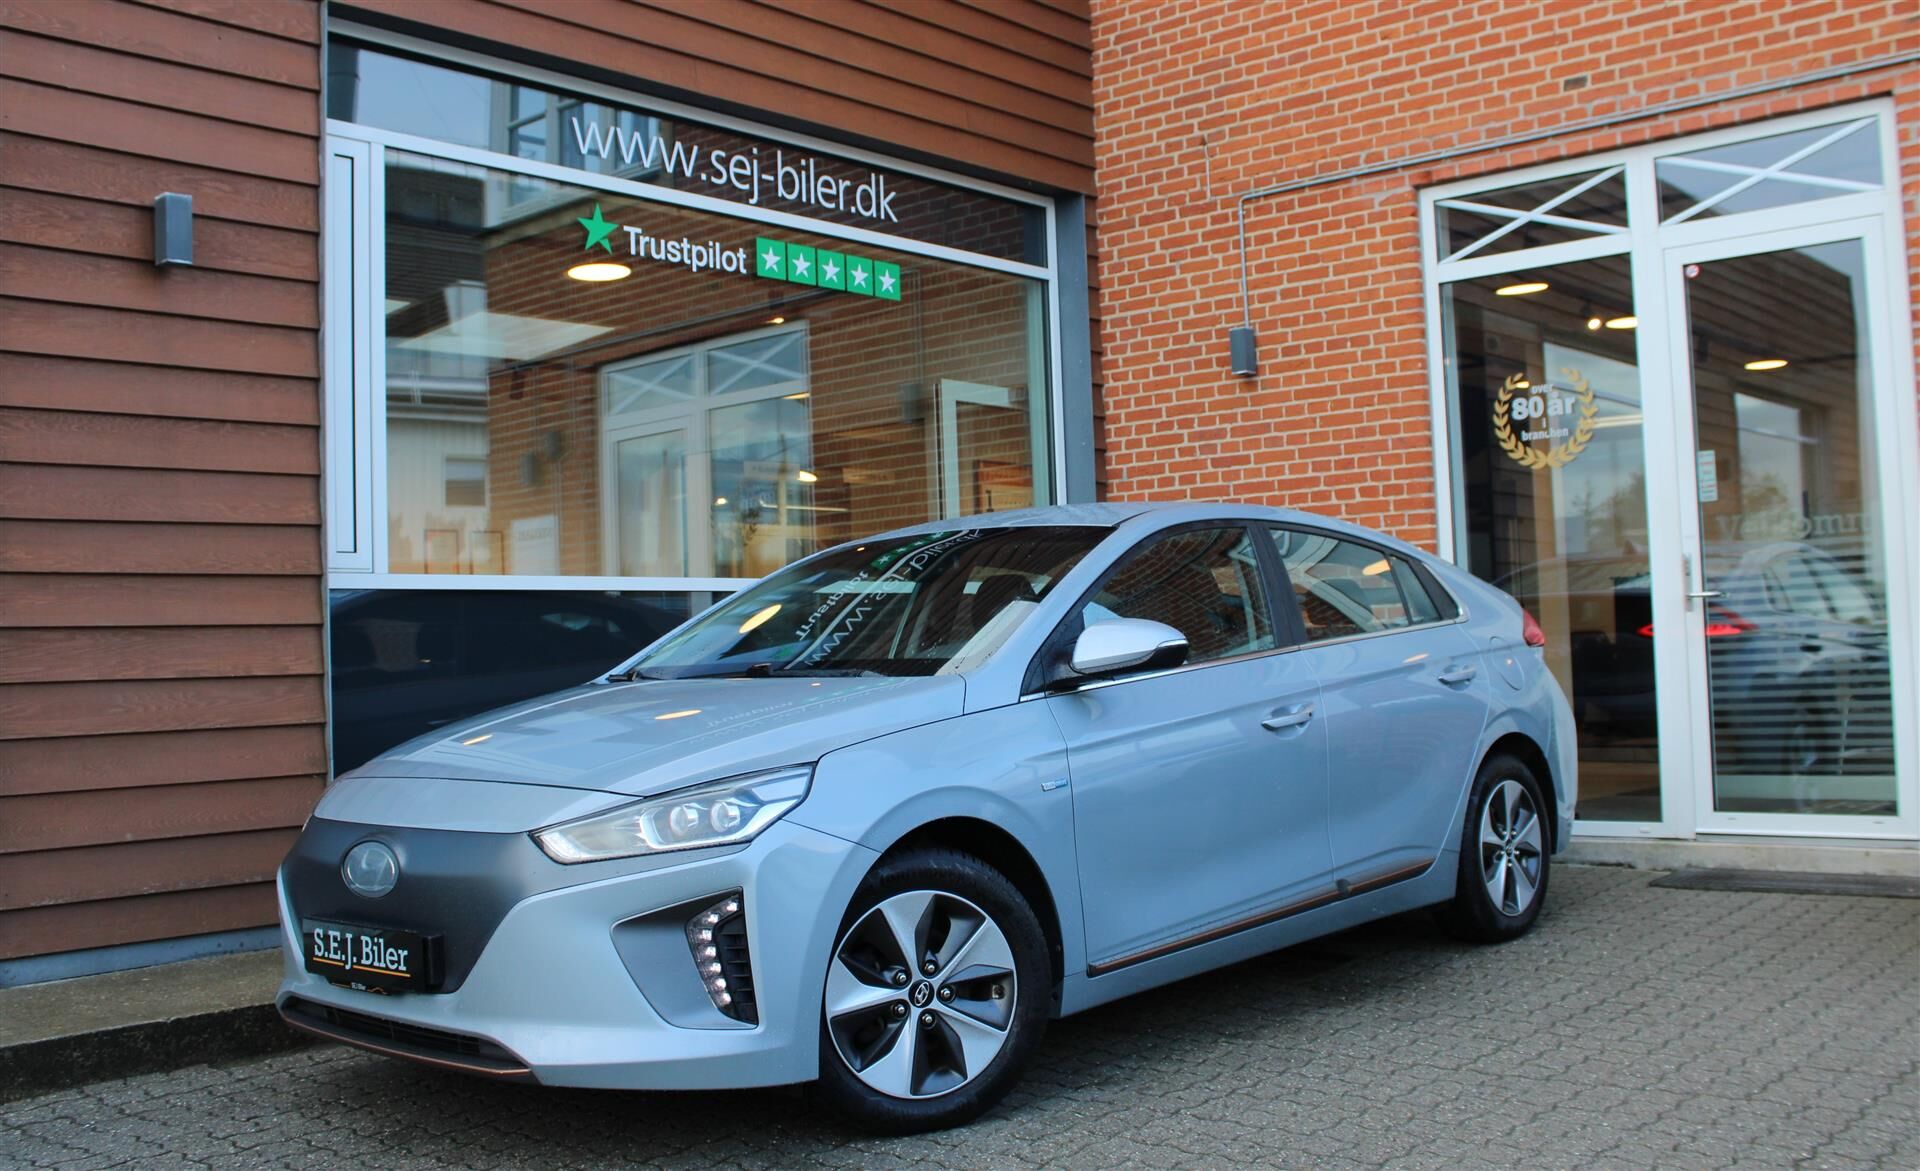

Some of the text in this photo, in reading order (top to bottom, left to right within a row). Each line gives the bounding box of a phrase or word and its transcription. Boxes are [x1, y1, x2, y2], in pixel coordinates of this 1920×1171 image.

[572, 116, 899, 223] www.sej-biler.dk
[623, 225, 747, 275] Trustpilot
[1512, 391, 1575, 420] 80 år
[313, 927, 409, 972] S.E.J. Biler
